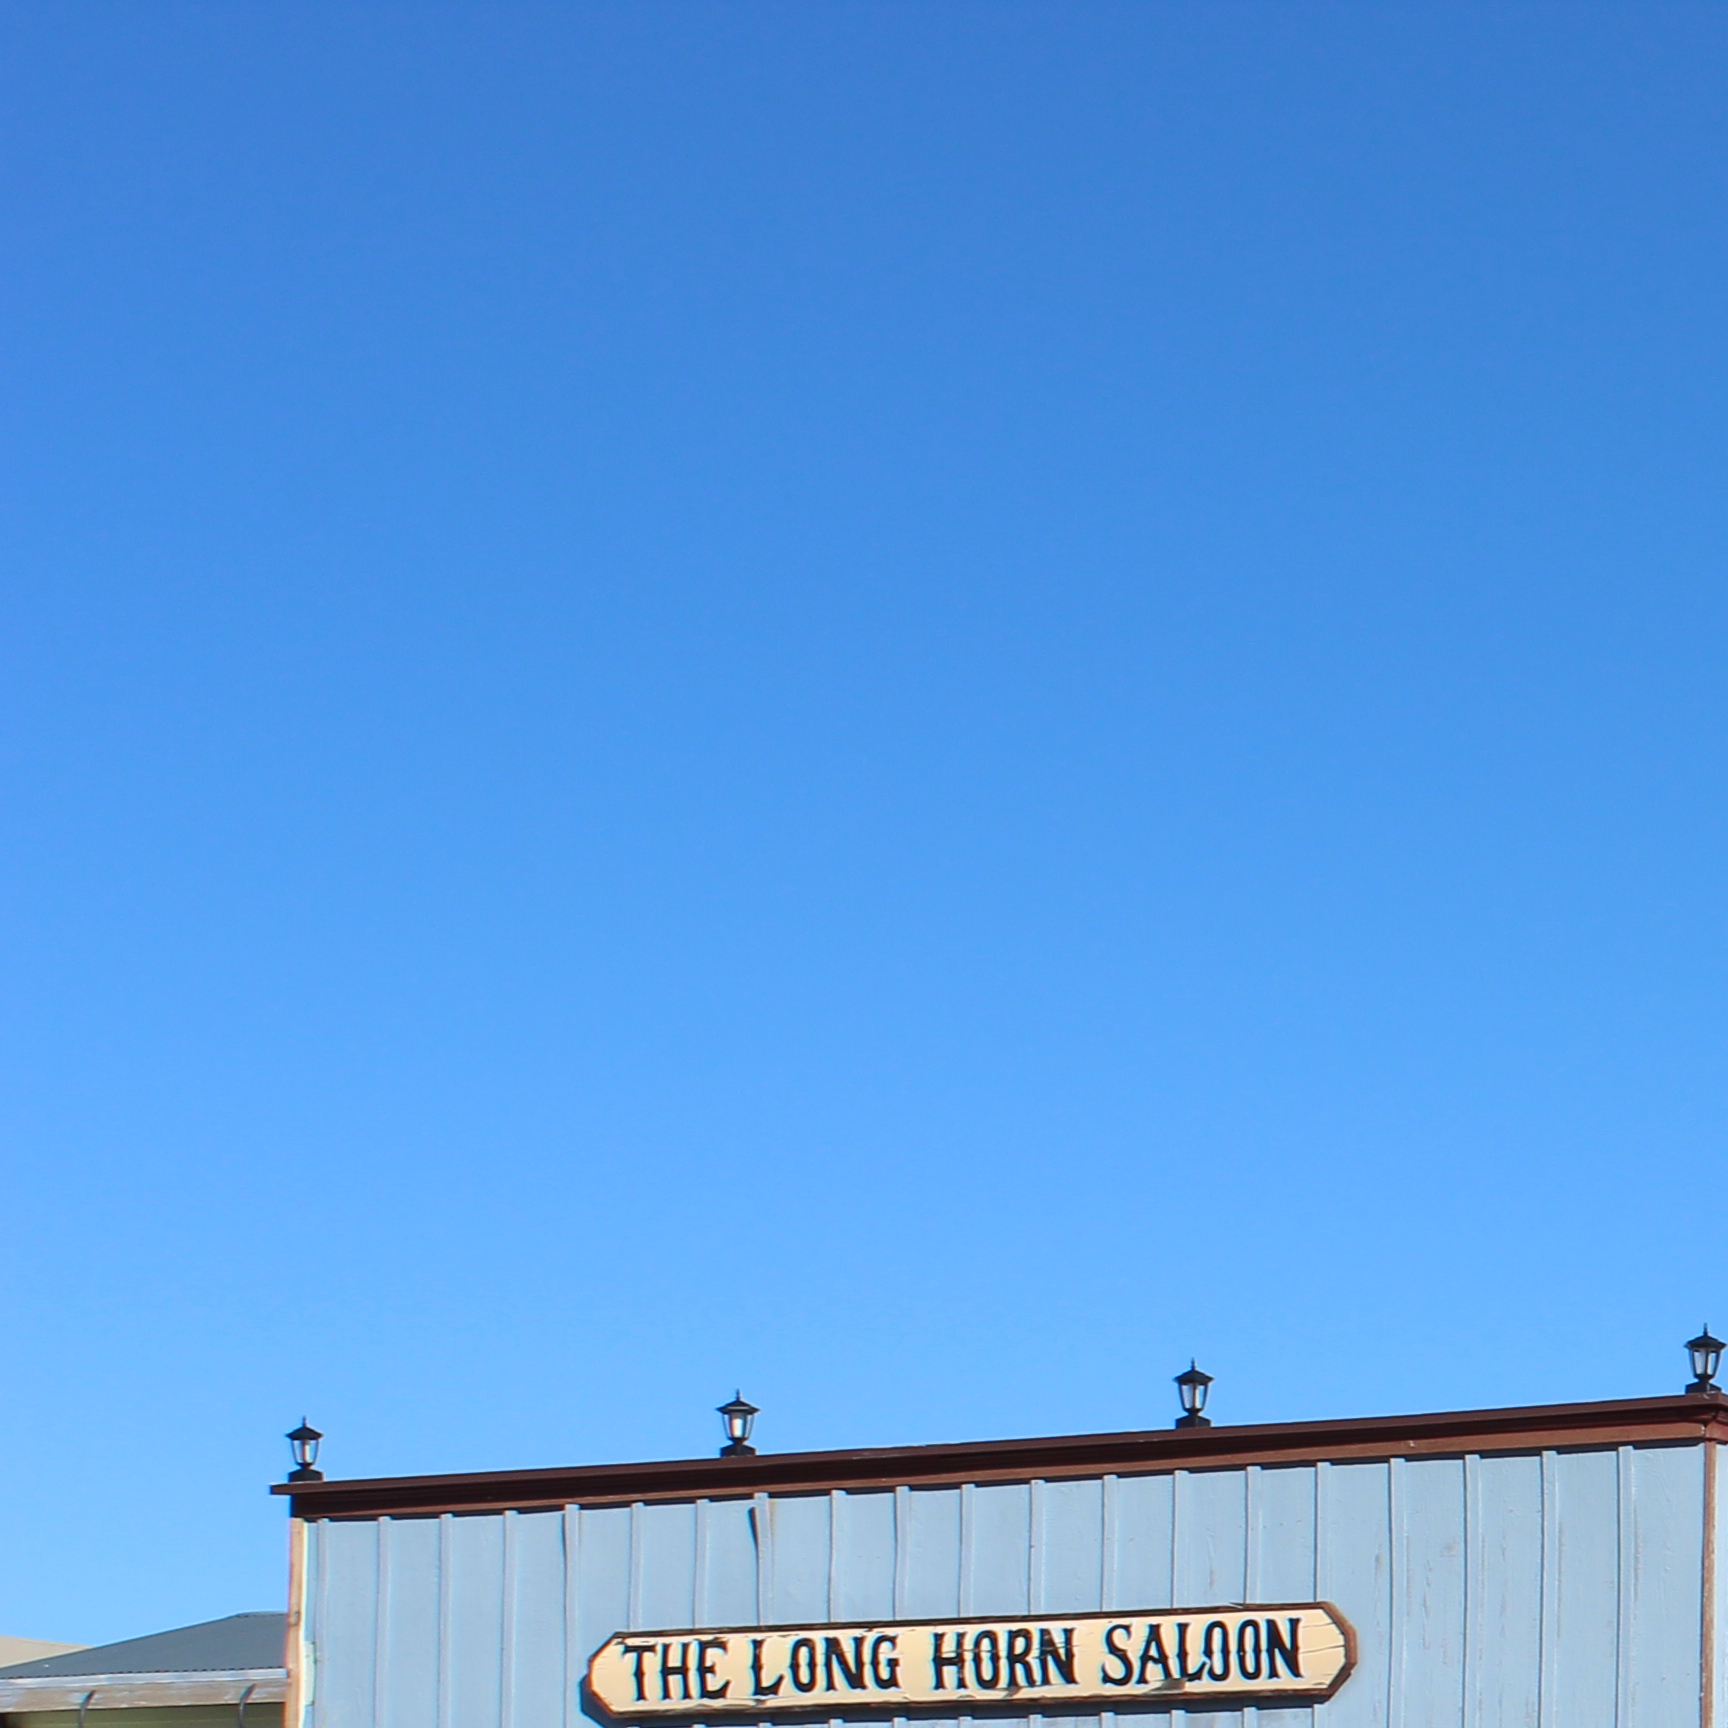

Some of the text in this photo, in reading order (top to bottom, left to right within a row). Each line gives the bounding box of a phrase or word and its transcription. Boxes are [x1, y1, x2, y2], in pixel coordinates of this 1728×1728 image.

[621, 1618, 1304, 1701] THE LONG HORN SALOON
